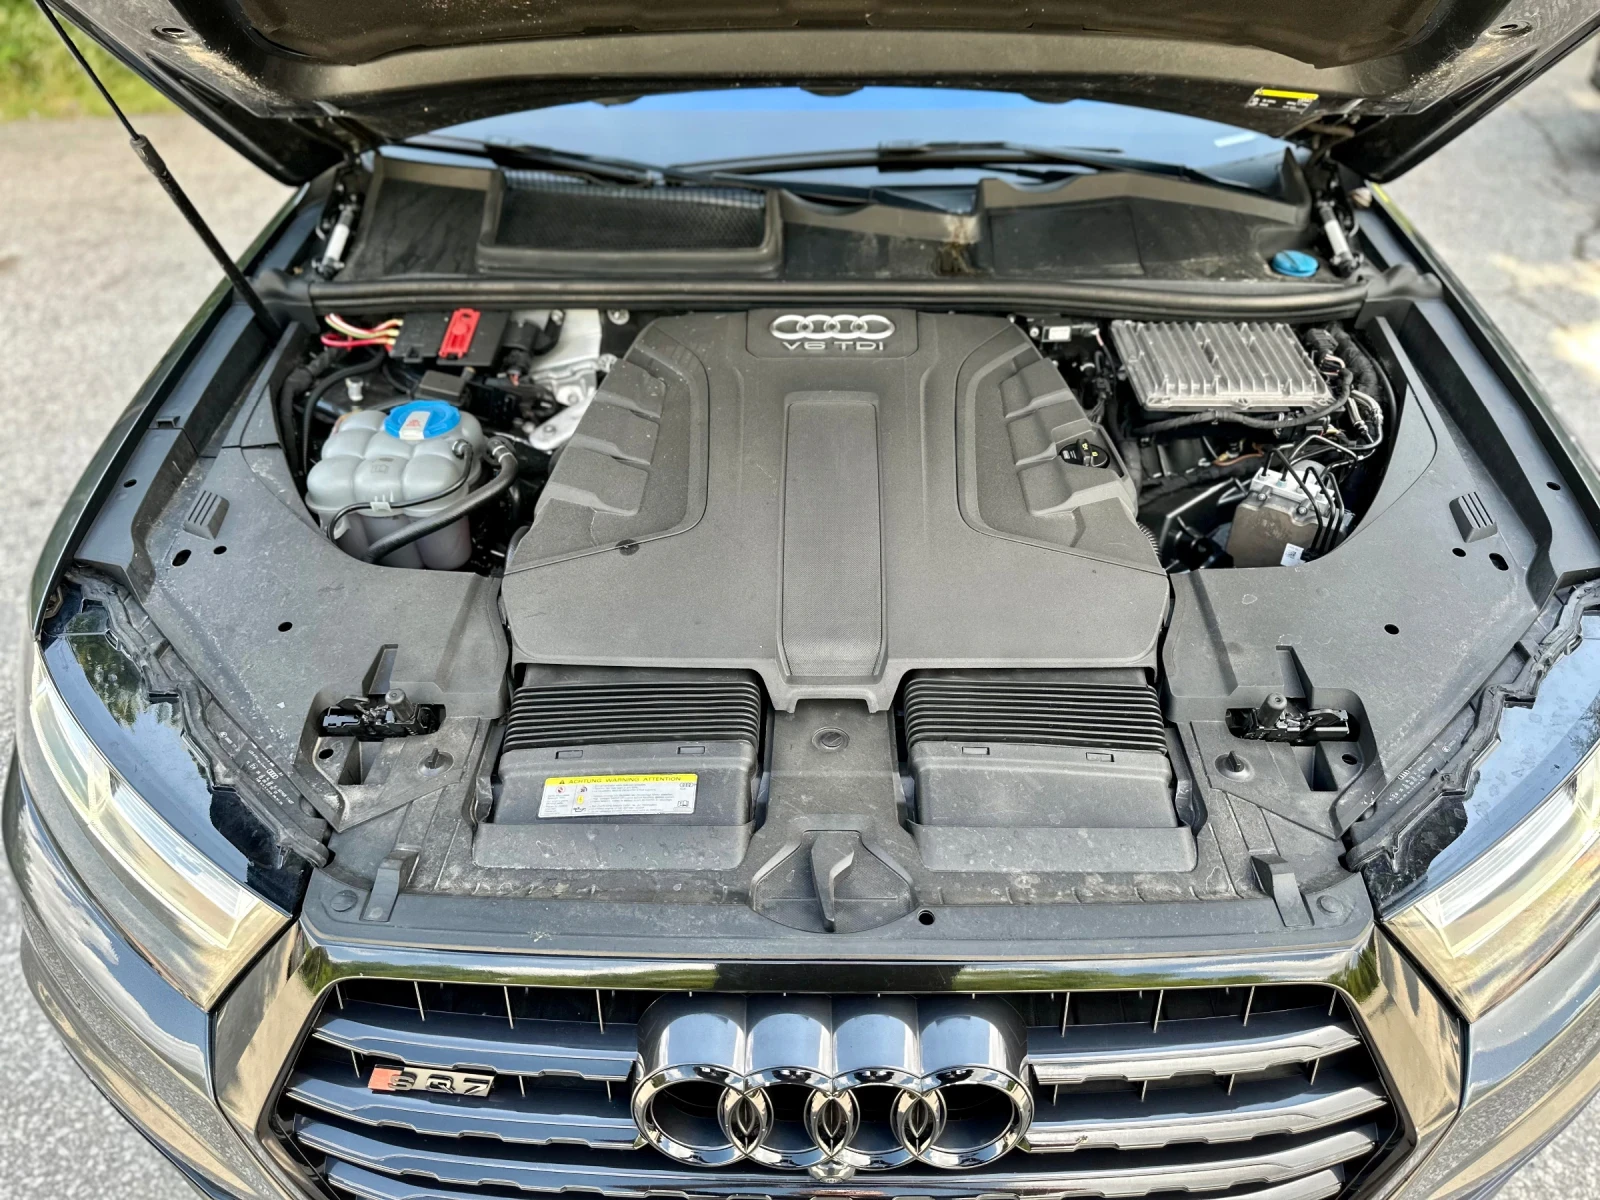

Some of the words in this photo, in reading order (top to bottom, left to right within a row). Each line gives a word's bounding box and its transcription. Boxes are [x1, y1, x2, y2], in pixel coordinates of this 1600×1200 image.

[782, 341, 826, 351] V6
[833, 341, 884, 351] TDI
[388, 1071, 490, 1095] SQ7
